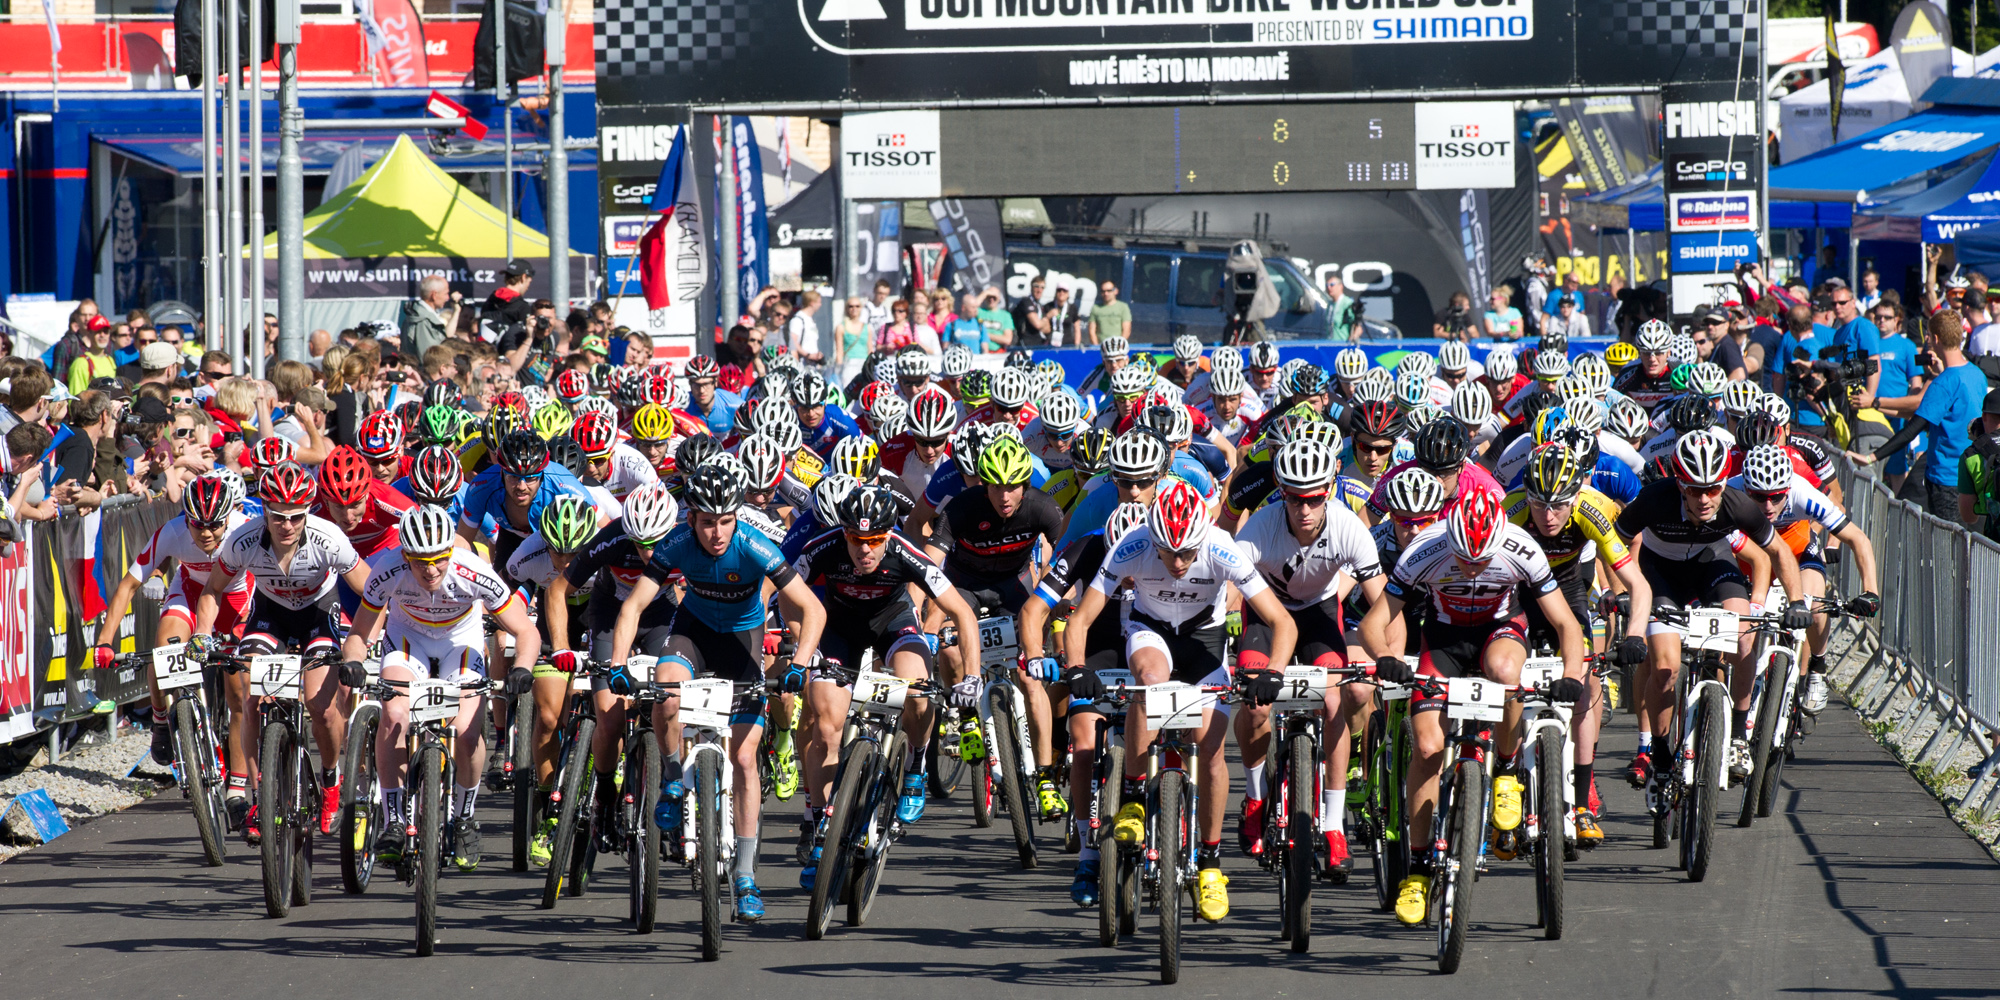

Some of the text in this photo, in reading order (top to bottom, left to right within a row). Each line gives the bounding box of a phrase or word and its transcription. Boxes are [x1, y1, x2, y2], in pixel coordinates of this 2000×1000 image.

[1258, 16, 1528, 42] PRESENTED BY SHIMANO
[1069, 51, 1290, 86] NOVÉ MĚSTO NA MORAVĚ
[1665, 101, 1757, 138] FINISH
[1273, 118, 1383, 144] 8 5
[602, 124, 690, 162] FINIS
[1419, 141, 1511, 158] TISSOT
[846, 151, 937, 167] TISSOT
[1676, 160, 1748, 174] GoPro
[1273, 161, 1290, 186] 0
[1694, 201, 1747, 213] Rubena
[1679, 244, 1750, 259] SHIMANO
[308, 264, 496, 283] www.suninvent.cz
[1790, 435, 1826, 460] FOCUS
[798, 450, 824, 473] eep
[1049, 478, 1070, 496] OTUBES
[1231, 478, 1265, 501] Alex Moeys
[1580, 500, 1612, 532] INTERBEST
[516, 548, 549, 568] MERID
[1116, 540, 1145, 559] KMC
[1211, 544, 1239, 565] KMC
[1501, 537, 1537, 561] BH
[900, 548, 926, 571] SCOTT
[1710, 572, 1732, 587] CRAFT
[1158, 590, 1199, 600] BH
[982, 626, 1003, 648] 33
[1708, 618, 1720, 636] 8
[166, 653, 188, 673] 29
[268, 662, 284, 682] 17
[1290, 678, 1309, 699] 12
[1541, 669, 1553, 689] 5
[702, 688, 712, 708] 7
[870, 683, 890, 704] 13
[1169, 691, 1177, 713] 1
[1470, 682, 1483, 702] 3
